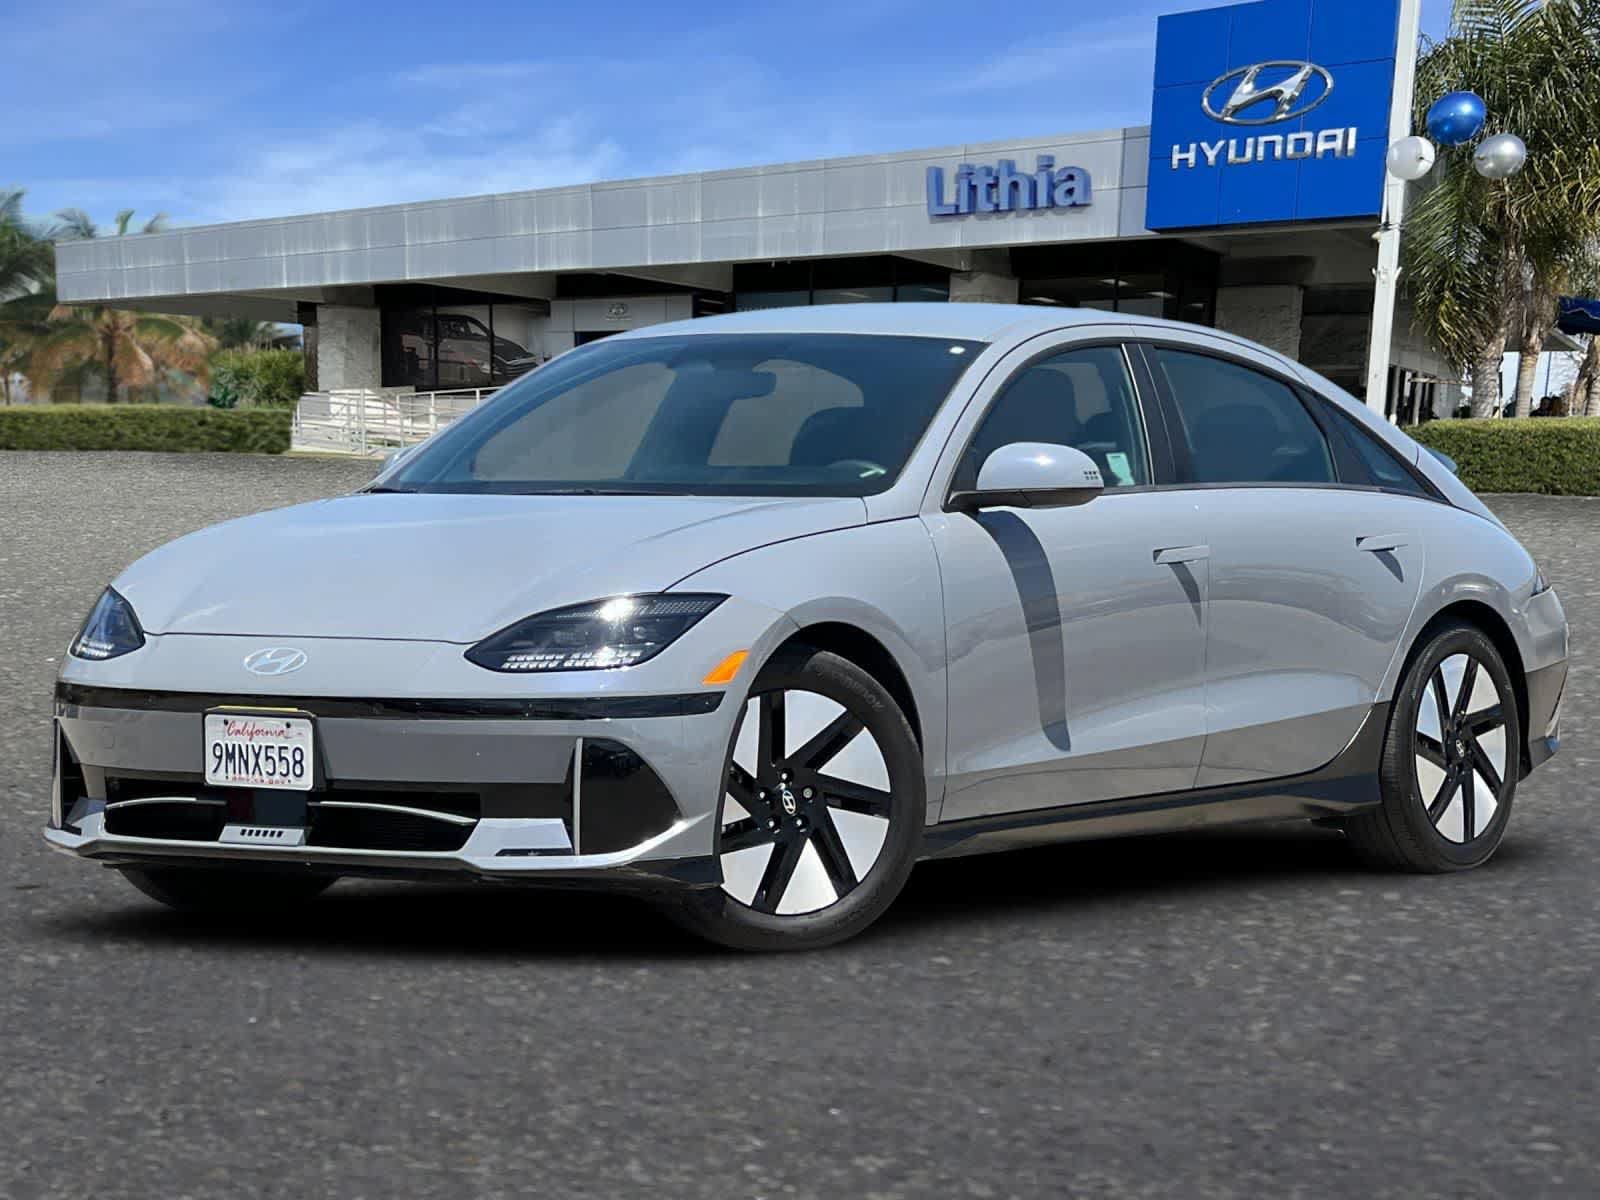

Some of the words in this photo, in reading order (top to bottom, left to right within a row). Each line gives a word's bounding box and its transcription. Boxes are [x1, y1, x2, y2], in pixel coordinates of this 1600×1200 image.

[1171, 127, 1357, 169] HYUNDAI
[926, 154, 1093, 218] Lithia
[227, 720, 286, 741] California
[212, 742, 304, 778] 9MNX558
